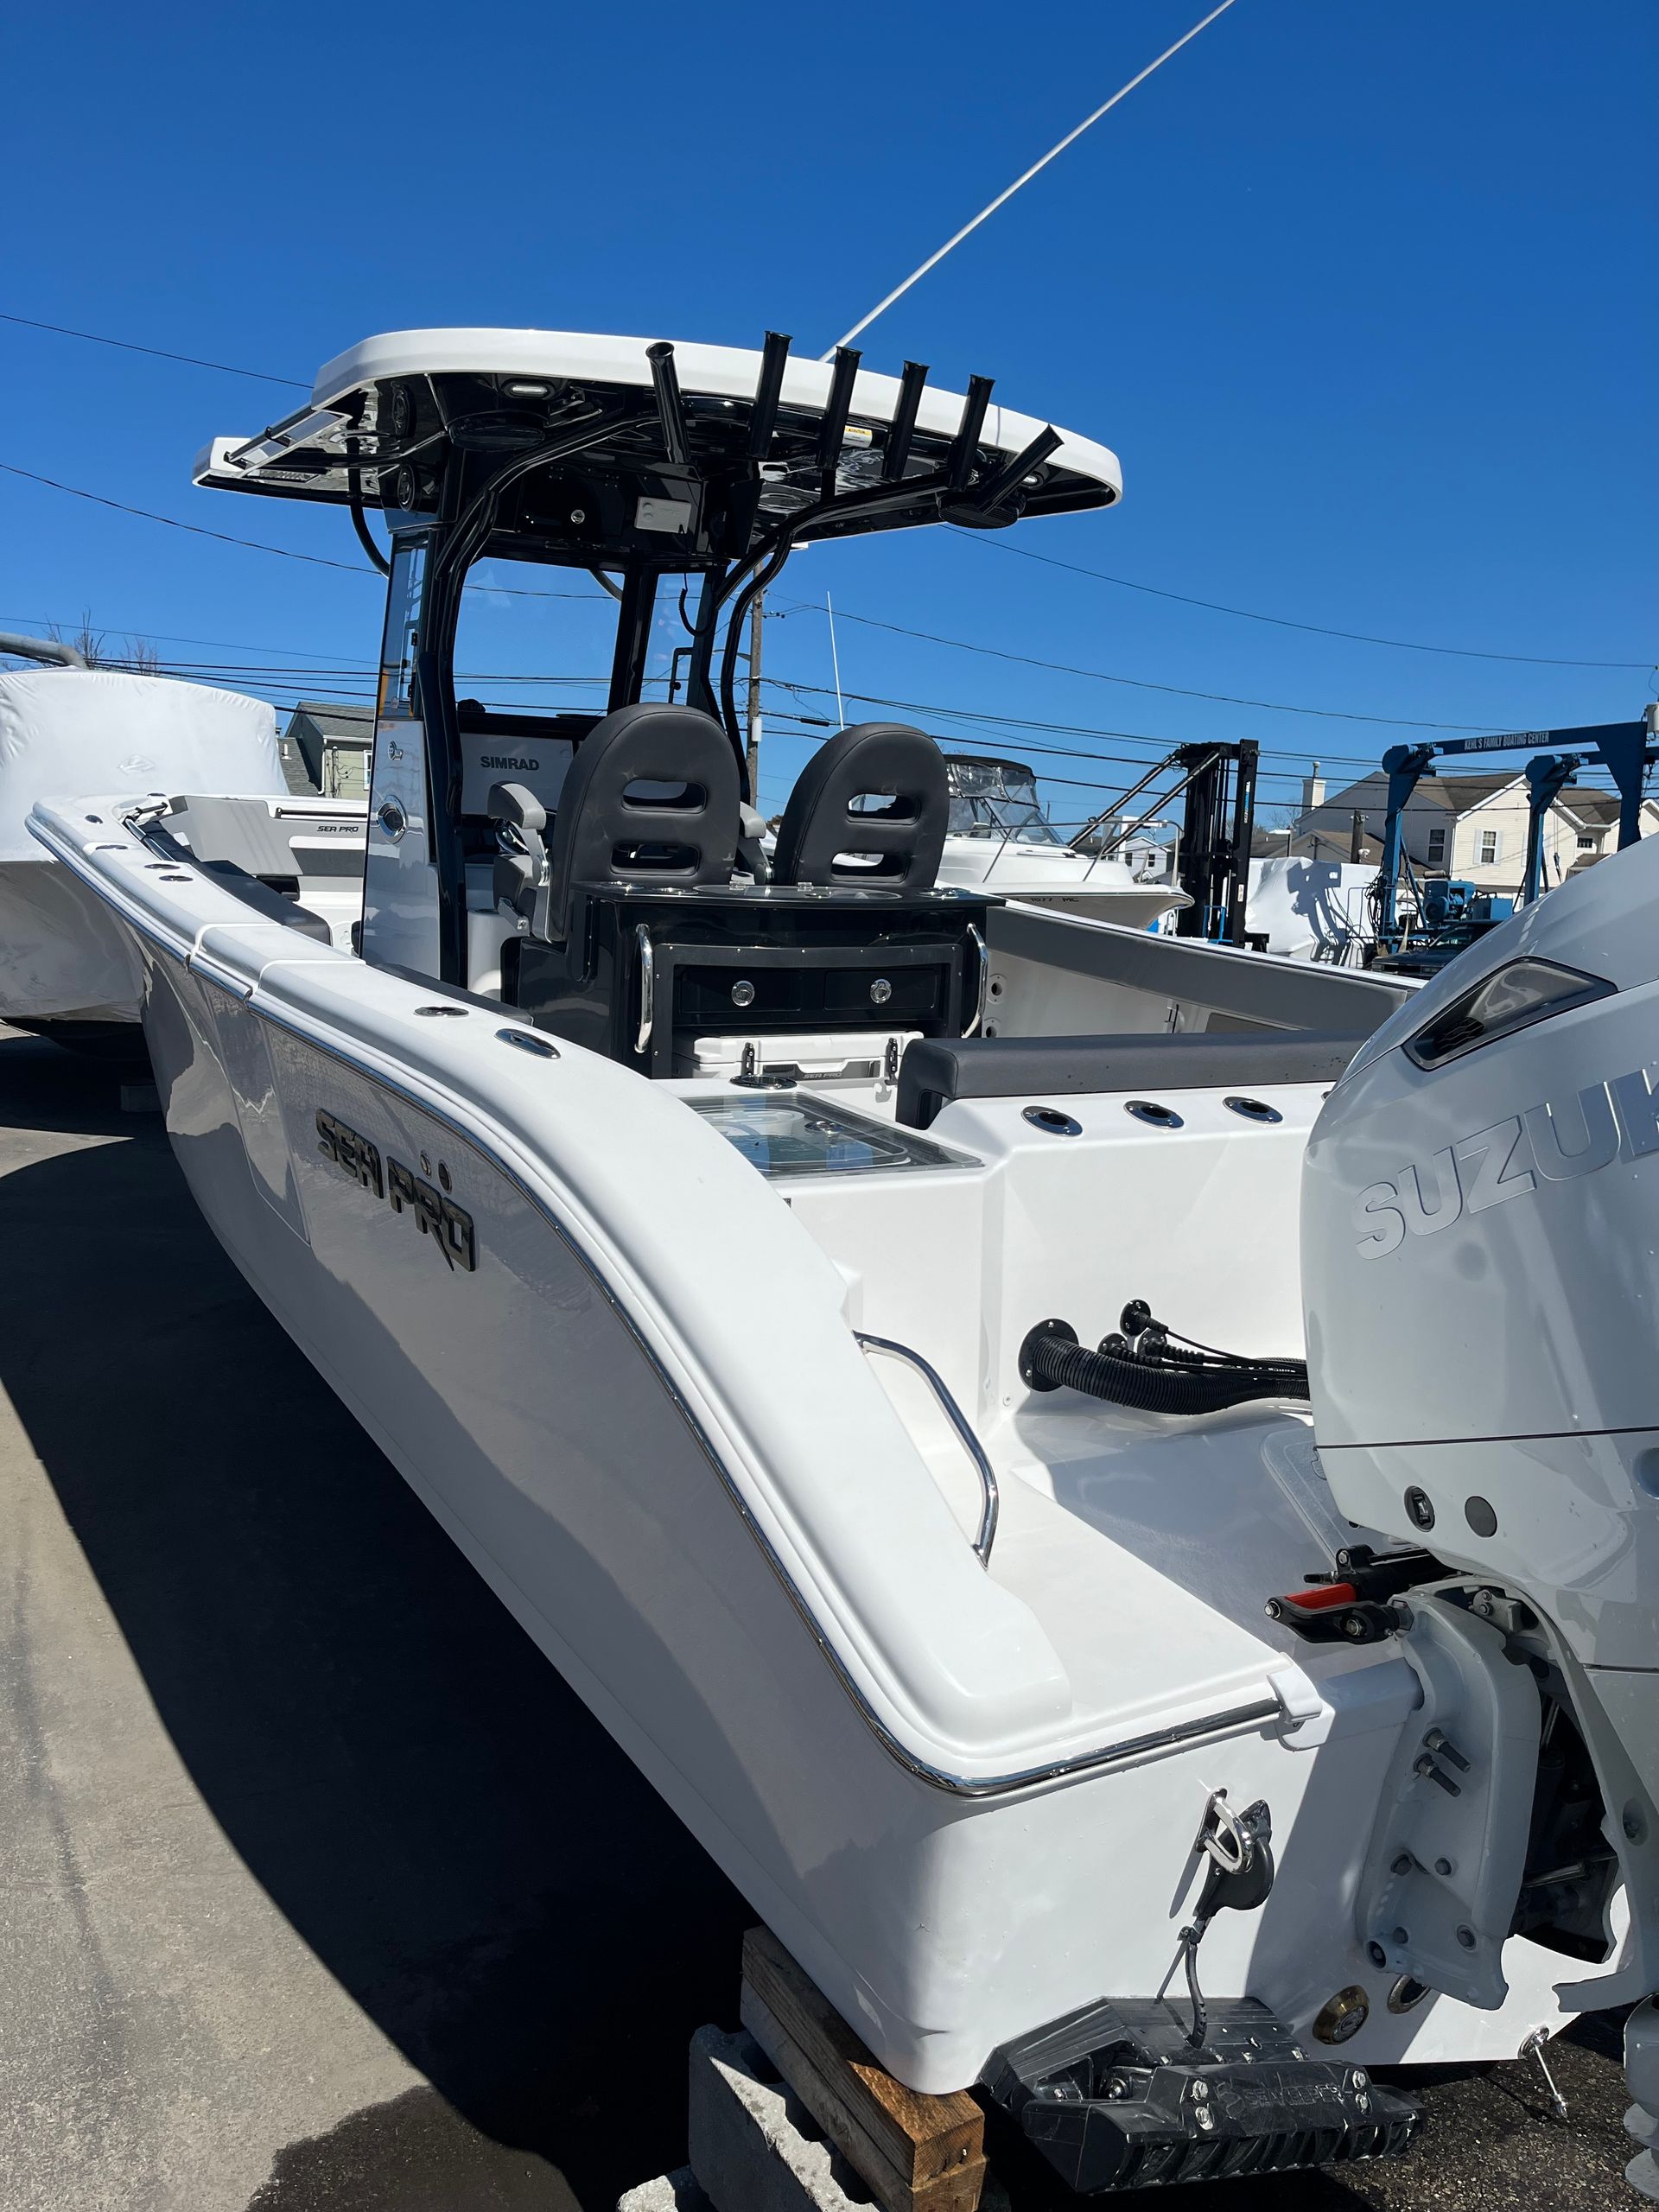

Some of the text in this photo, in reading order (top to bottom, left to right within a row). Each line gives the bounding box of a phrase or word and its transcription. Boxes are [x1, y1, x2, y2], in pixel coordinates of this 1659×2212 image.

[1483, 735, 1503, 748] FAMILY
[1503, 733, 1527, 747] BOATING
[1528, 731, 1549, 744] CENTER
[480, 755, 540, 771] SIMRAD
[316, 1108, 476, 1272] SEA PRO
